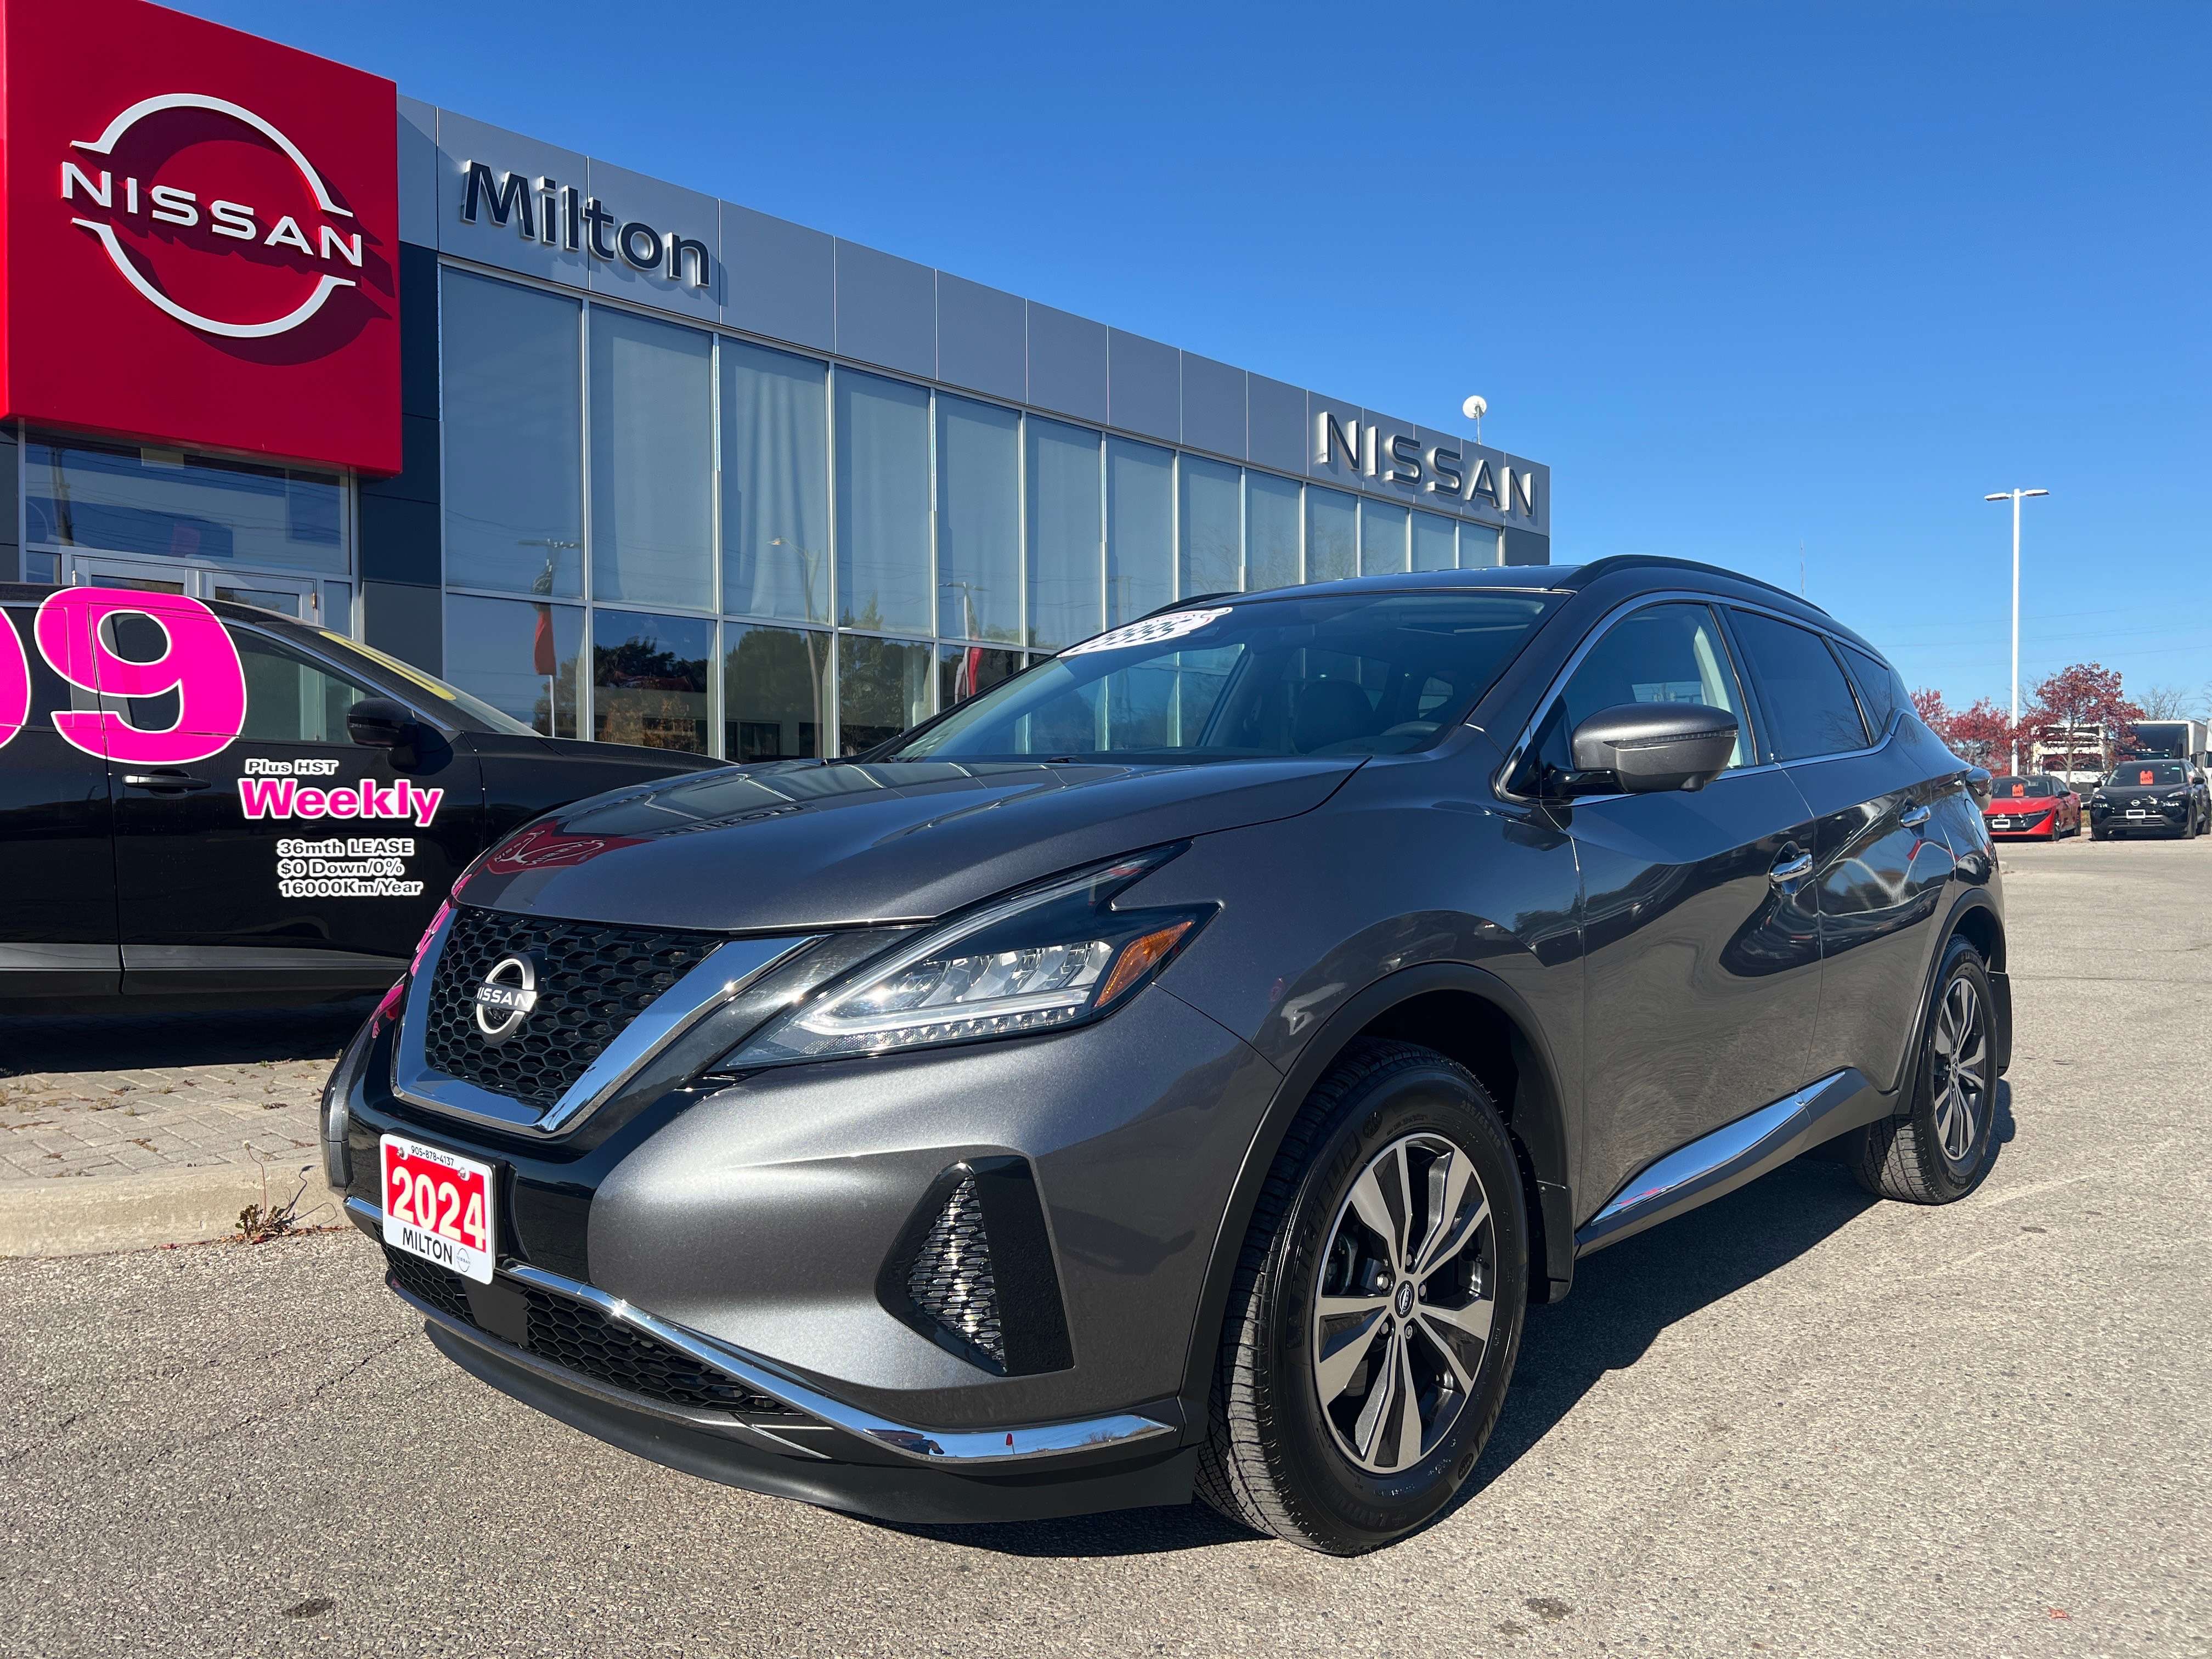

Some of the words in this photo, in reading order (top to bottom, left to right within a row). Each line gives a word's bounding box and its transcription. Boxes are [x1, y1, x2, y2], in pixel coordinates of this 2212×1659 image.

[61, 161, 363, 268] NISSAN
[461, 159, 711, 288] Milton
[1319, 411, 1534, 517] NISSAN
[246, 759, 291, 774] Plus
[295, 760, 338, 774] HST
[239, 778, 443, 826] Weekly
[278, 839, 344, 856] 36mth
[348, 839, 414, 855] LEASE
[279, 859, 306, 878] $0
[311, 859, 404, 877] Down/0%
[279, 879, 422, 896] 16000Km/Year
[411, 1145, 454, 1166] 905-878-4137
[392, 1166, 486, 1250] 2024
[403, 1227, 453, 1265] MILTON
